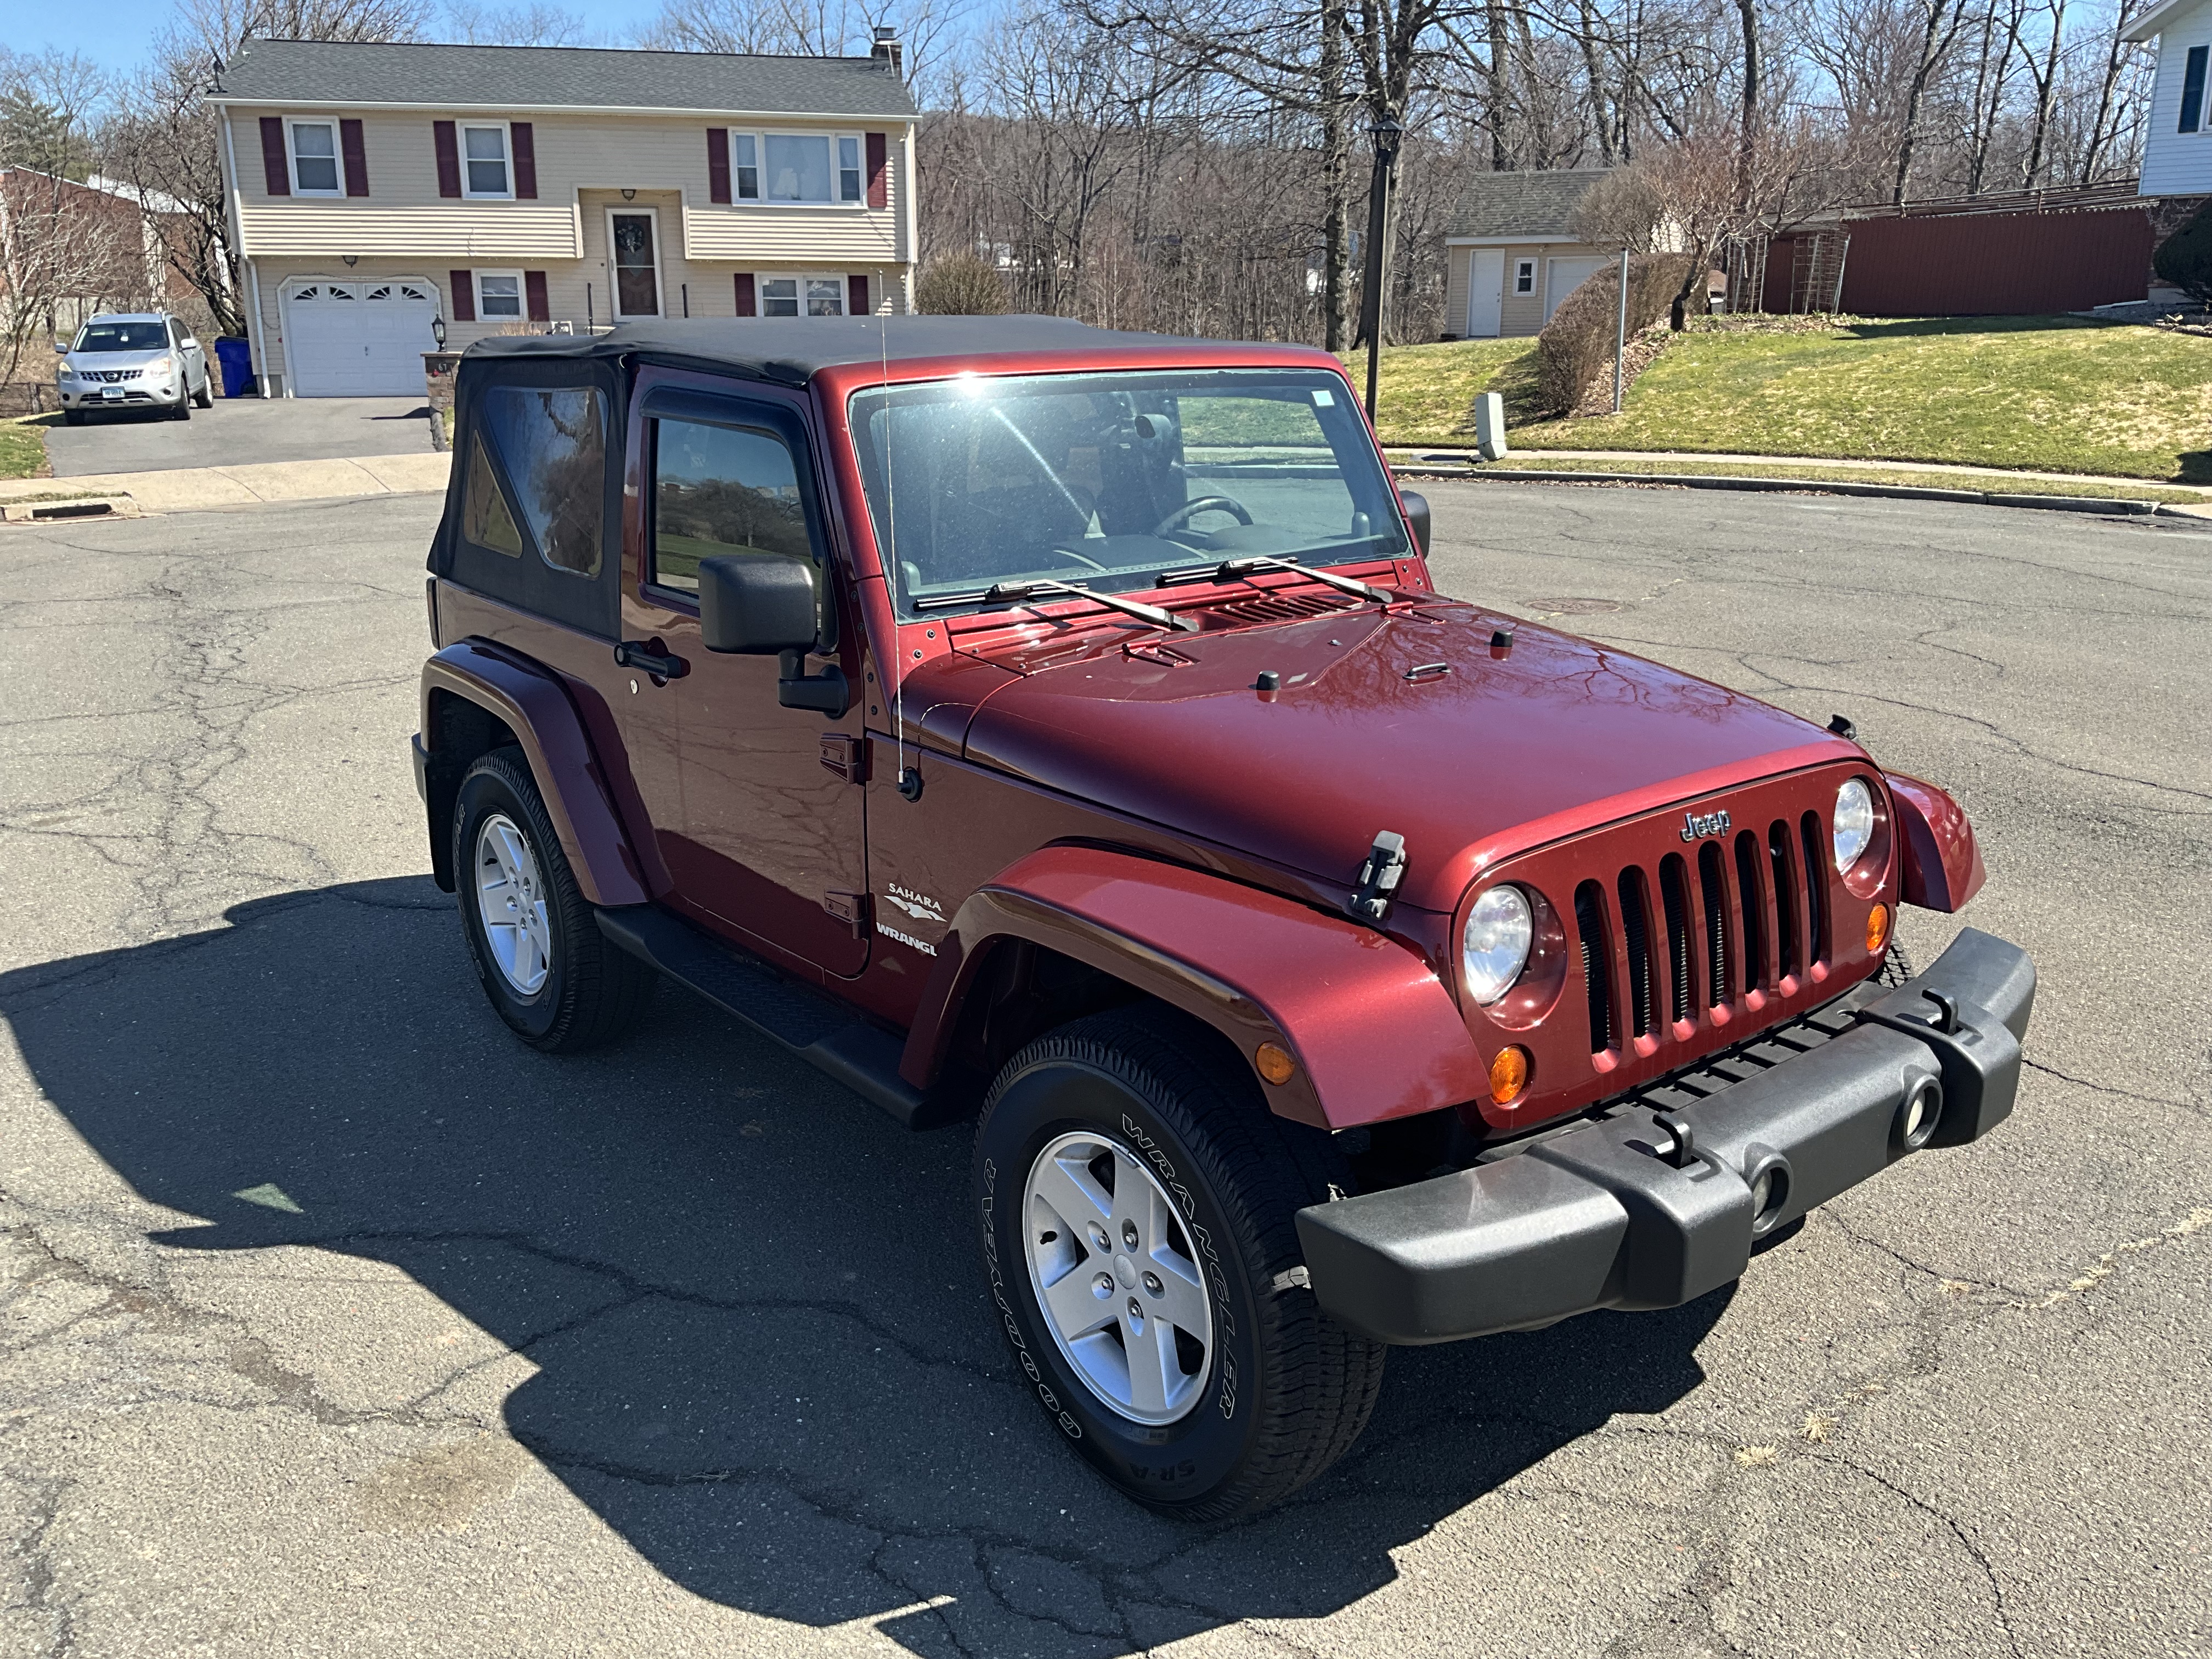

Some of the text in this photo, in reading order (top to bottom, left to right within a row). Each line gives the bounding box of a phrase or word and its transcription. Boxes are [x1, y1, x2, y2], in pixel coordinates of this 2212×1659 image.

[888, 882, 943, 912] SAHARA
[1680, 810, 1732, 842] Jeep
[981, 1158, 1082, 1438] GOODYEAR
[1122, 1113, 1238, 1420] WRANGLER
